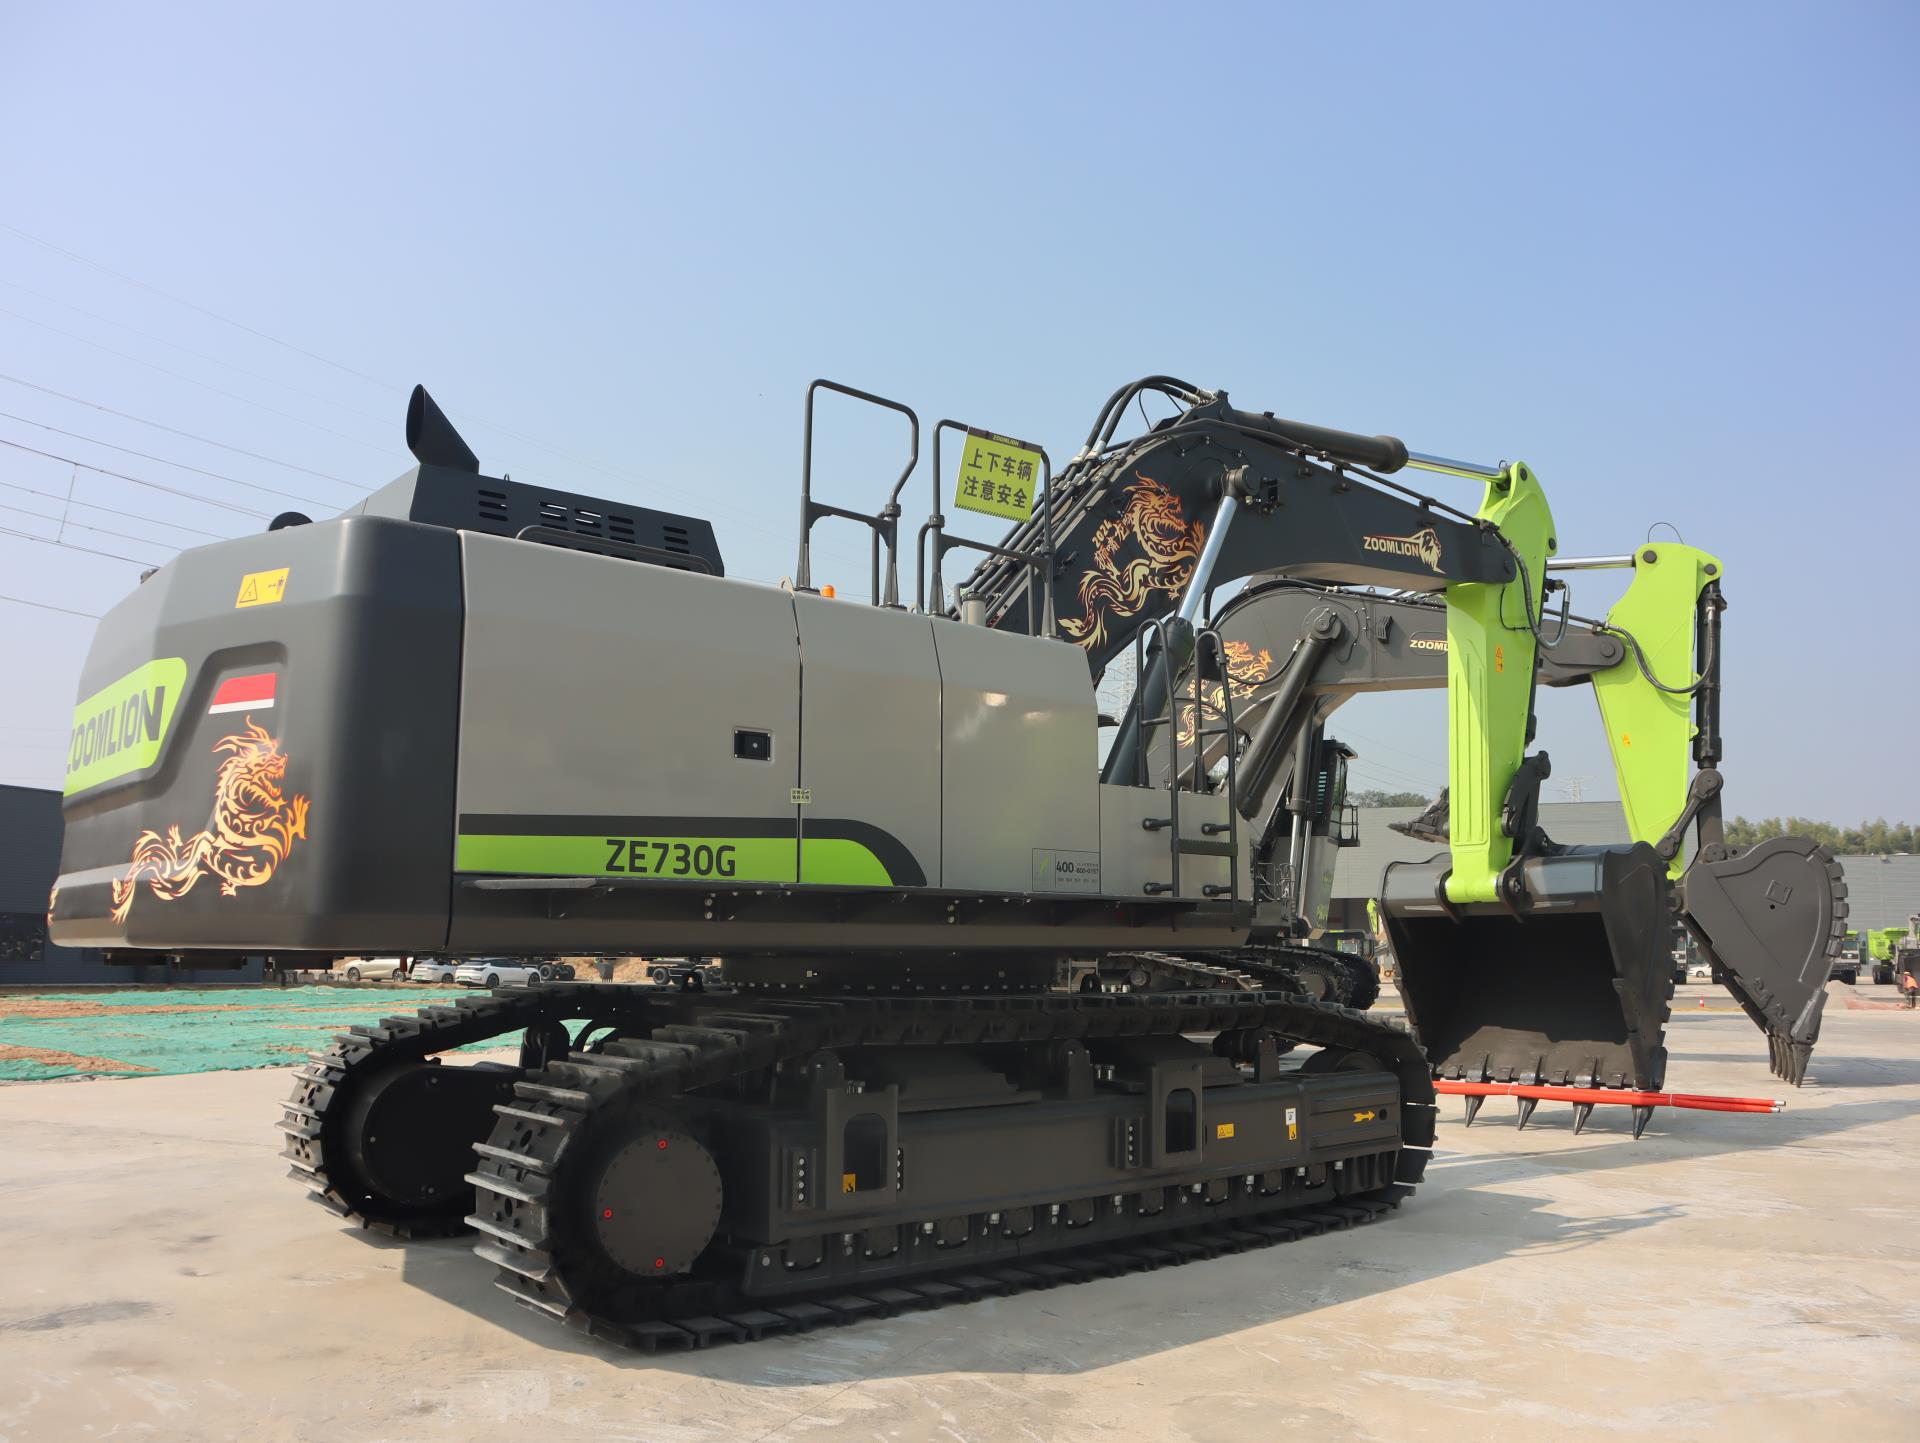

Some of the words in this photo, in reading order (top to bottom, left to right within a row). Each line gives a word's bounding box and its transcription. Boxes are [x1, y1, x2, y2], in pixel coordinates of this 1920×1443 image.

[967, 448, 1033, 481] 上下车辆
[963, 475, 1027, 509] 注意安全
[1092, 519, 1112, 548] 2024
[1363, 536, 1420, 557] ZOOMLION
[1409, 639, 1448, 652] ZOOML
[66, 685, 165, 774] OOMLION
[605, 839, 736, 876] ZE730G
[1056, 861, 1074, 873] 400
